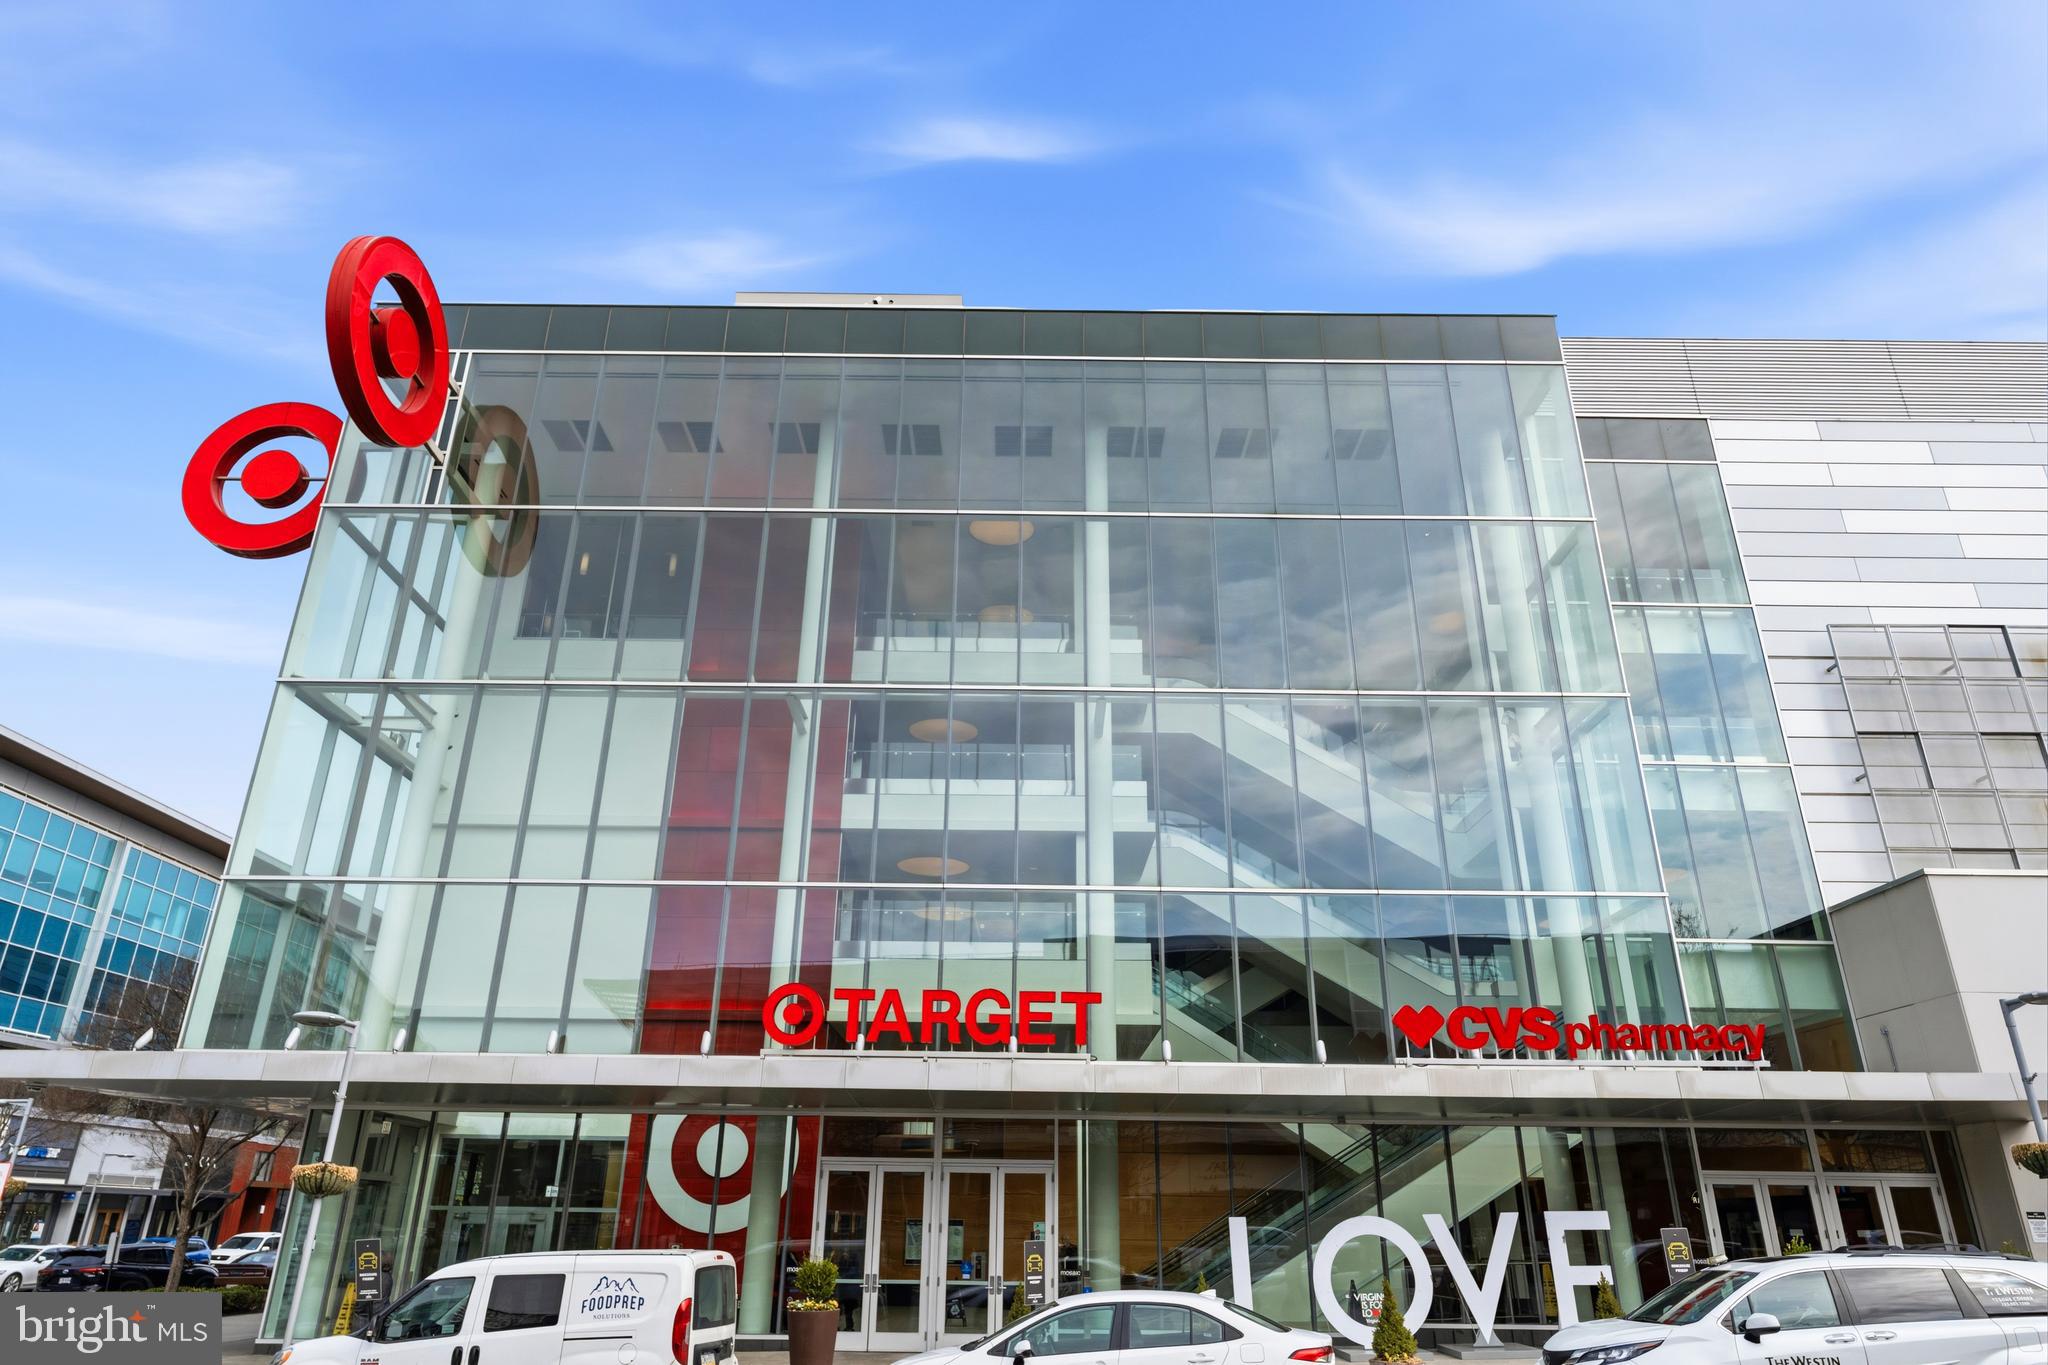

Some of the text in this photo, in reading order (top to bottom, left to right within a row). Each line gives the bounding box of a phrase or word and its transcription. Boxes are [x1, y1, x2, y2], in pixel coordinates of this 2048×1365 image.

[834, 988, 1102, 1045] TARGET
[1446, 1005, 1765, 1061] CVS pharmacy
[581, 1295, 645, 1314] FOODPREP
[1353, 1292, 1384, 1301] VIRGIN
